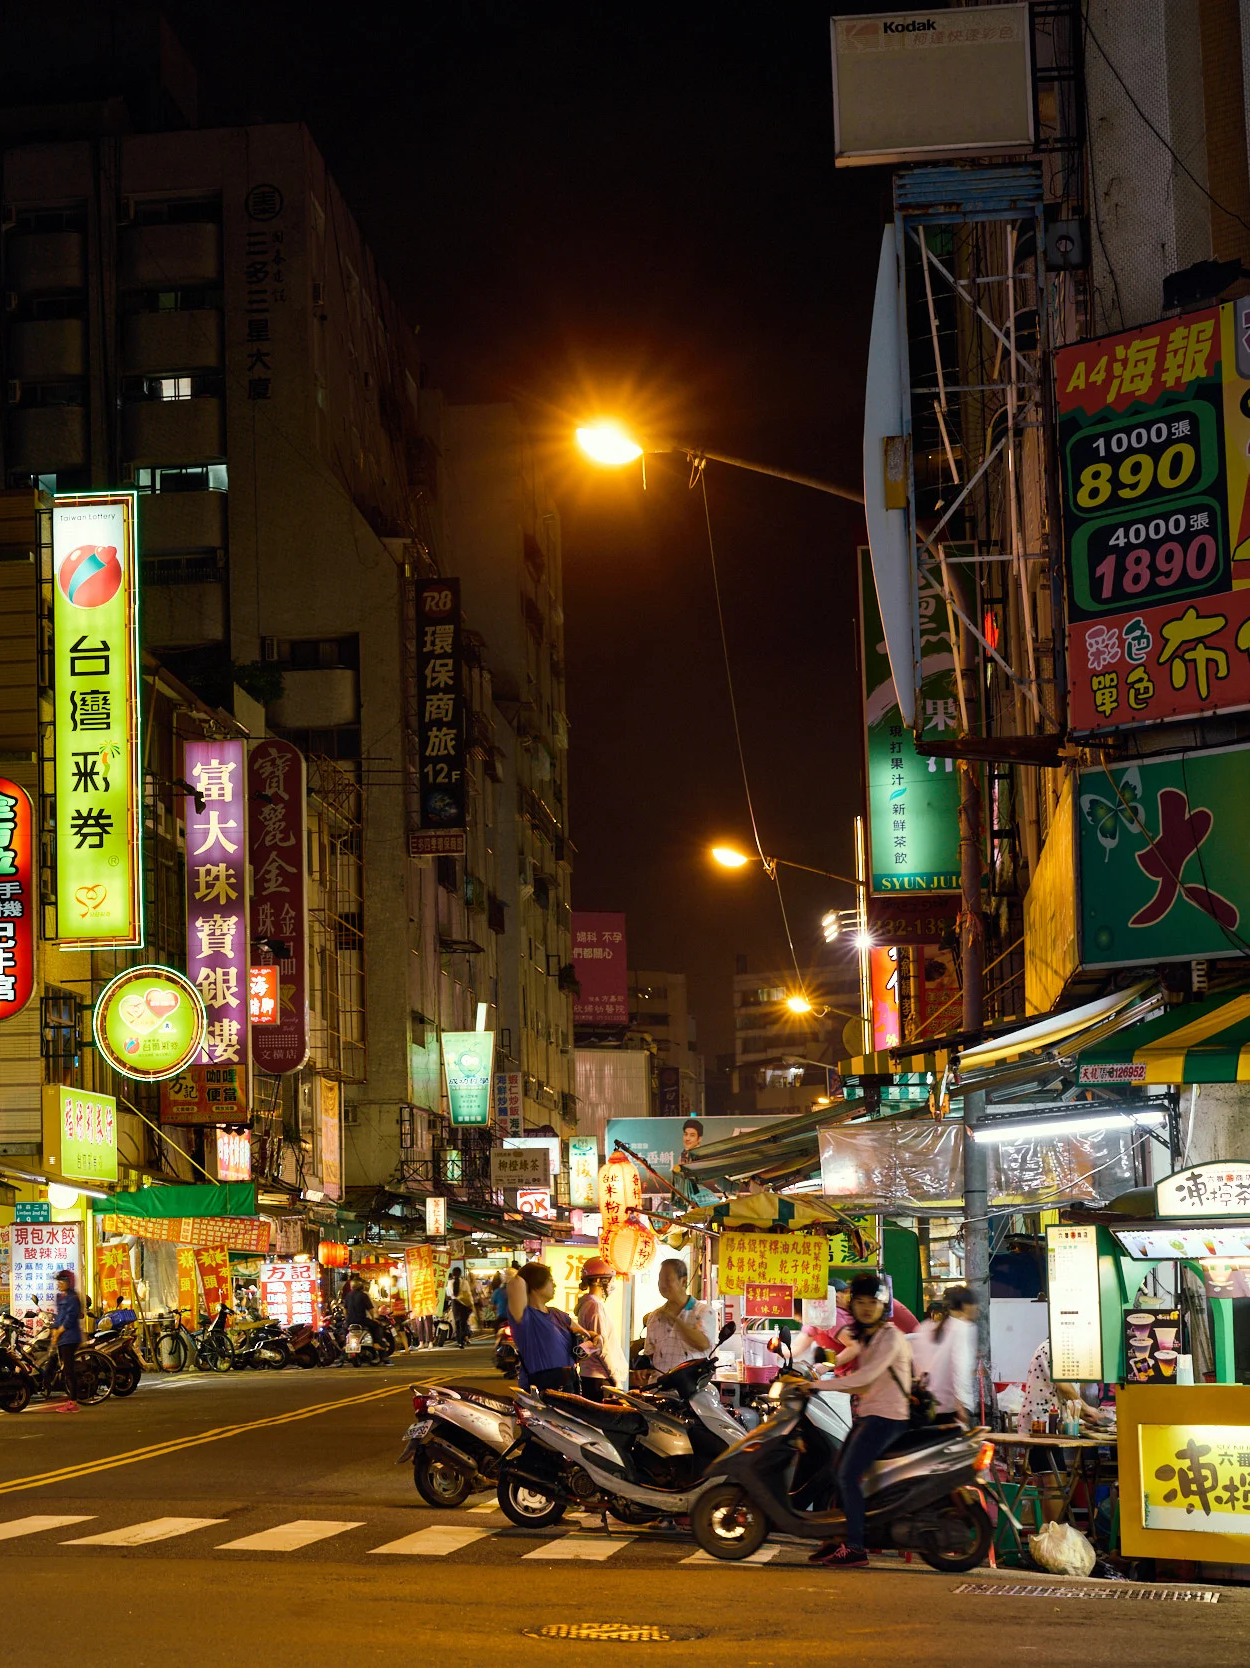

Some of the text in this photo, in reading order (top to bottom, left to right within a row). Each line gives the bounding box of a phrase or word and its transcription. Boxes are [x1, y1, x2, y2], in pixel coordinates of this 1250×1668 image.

[883, 19, 937, 34] Kodak
[1066, 320, 1216, 403] A4海報
[1092, 418, 1191, 458] 1000張
[1076, 442, 1196, 509] 890
[88, 513, 116, 521] Lottery
[1108, 512, 1211, 548] 4000張
[1094, 534, 1217, 599] 1890
[1086, 616, 1153, 671] 彩色
[424, 625, 457, 756] 環保商旅
[1091, 665, 1155, 718] 單色
[69, 635, 121, 850] 台灣彩券
[889, 724, 905, 786] 現打果汁
[424, 763, 461, 784] 12F
[253, 748, 298, 897] 寶麗金
[892, 803, 908, 865] 新鮮茶飲
[881, 876, 927, 891] SYUN
[193, 758, 240, 1064] 富大珠寶銀樓
[573, 947, 613, 959] 們都關心
[576, 931, 623, 943] 婦科 不孕
[260, 1049, 297, 1060] 文橫店
[169, 1075, 198, 1099] 方記
[206, 1069, 237, 1083] 咖哩
[206, 1088, 237, 1102] 便當
[497, 1074, 509, 1116] 海鮮炒麵
[508, 1074, 519, 1116] 蝦仁炒飯
[603, 1174, 620, 1184] 台北
[520, 1197, 548, 1213] OK
[14, 1228, 76, 1245] 現包水餃
[23, 1248, 68, 1260] 酸辣湯
[267, 1265, 311, 1279] 方記
[726, 1238, 735, 1290] 陽春麵
[757, 1239, 768, 1284] 榨菜肉絲
[801, 1241, 812, 1294] 餛飩湯
[811, 1241, 823, 1294] 榨菜肉絲湯
